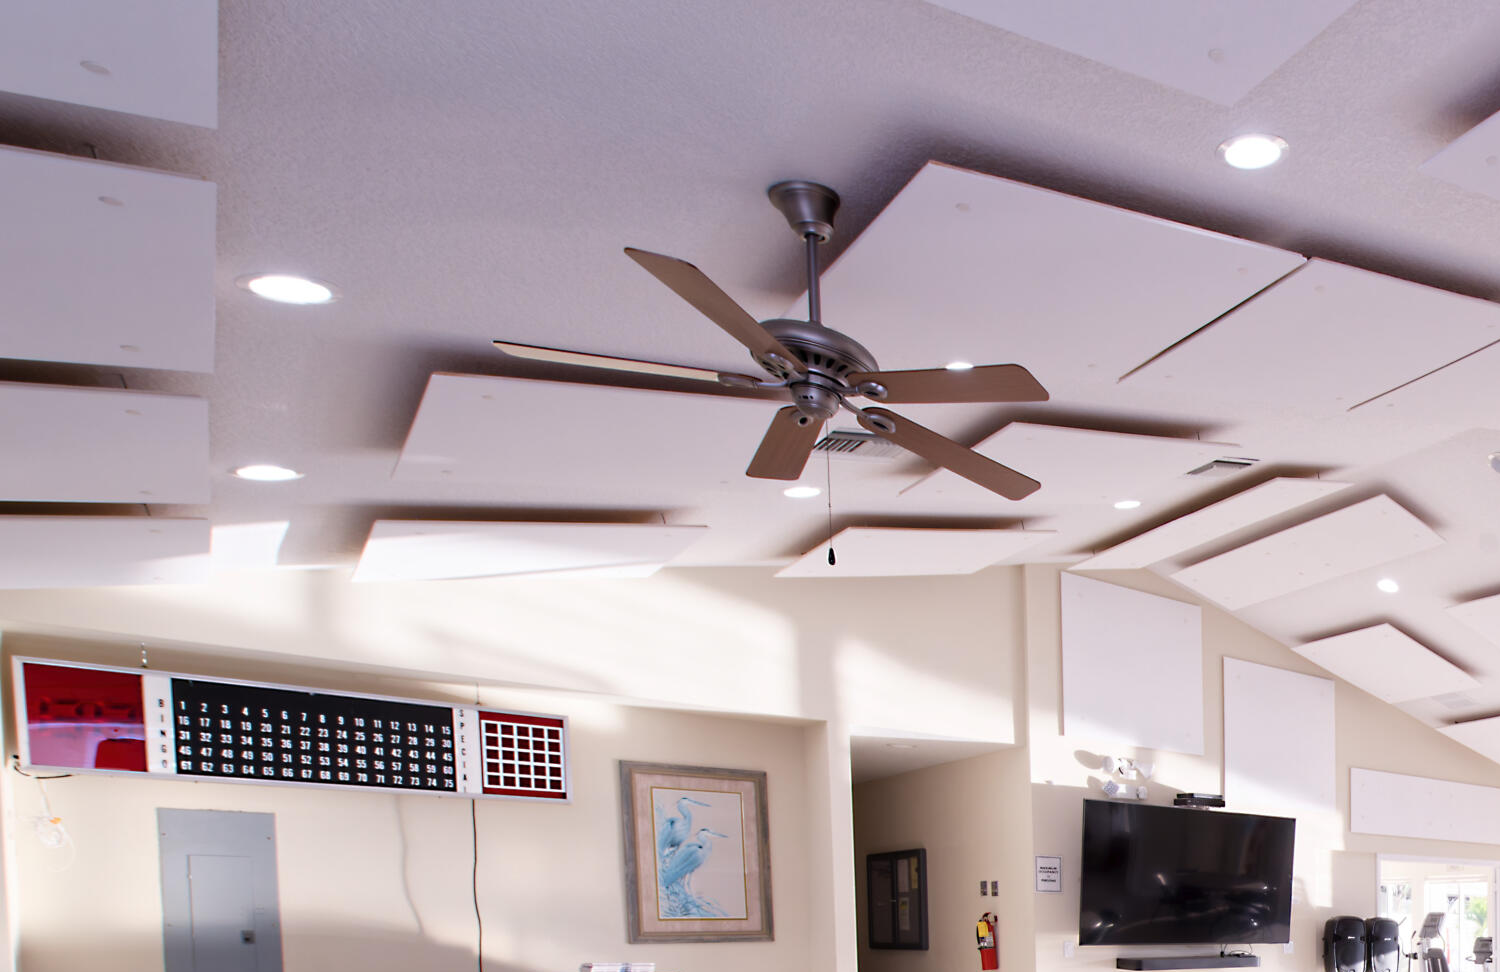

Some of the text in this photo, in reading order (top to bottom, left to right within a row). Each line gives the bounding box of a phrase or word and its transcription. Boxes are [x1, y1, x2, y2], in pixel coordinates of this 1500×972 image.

[158, 698, 168, 768] BINGO
[178, 716, 452, 748] 16 17 18 19 20 21 22 23 24 25 26 27 28 29 30
[180, 700, 450, 734] 1 2 3 4 5 6 7 8 9 10 11 12 13 14 15
[180, 730, 452, 762] 31 32 33 34 35 36 37 38 39 40 41 42 43 44 45
[180, 746, 454, 774] 46 47 48 49 50 51 52 53 54 55 56 57 58 59 60
[180, 760, 454, 788] 61 62 63 64 65 66 67 68 69 70 71 72 73 74 75
